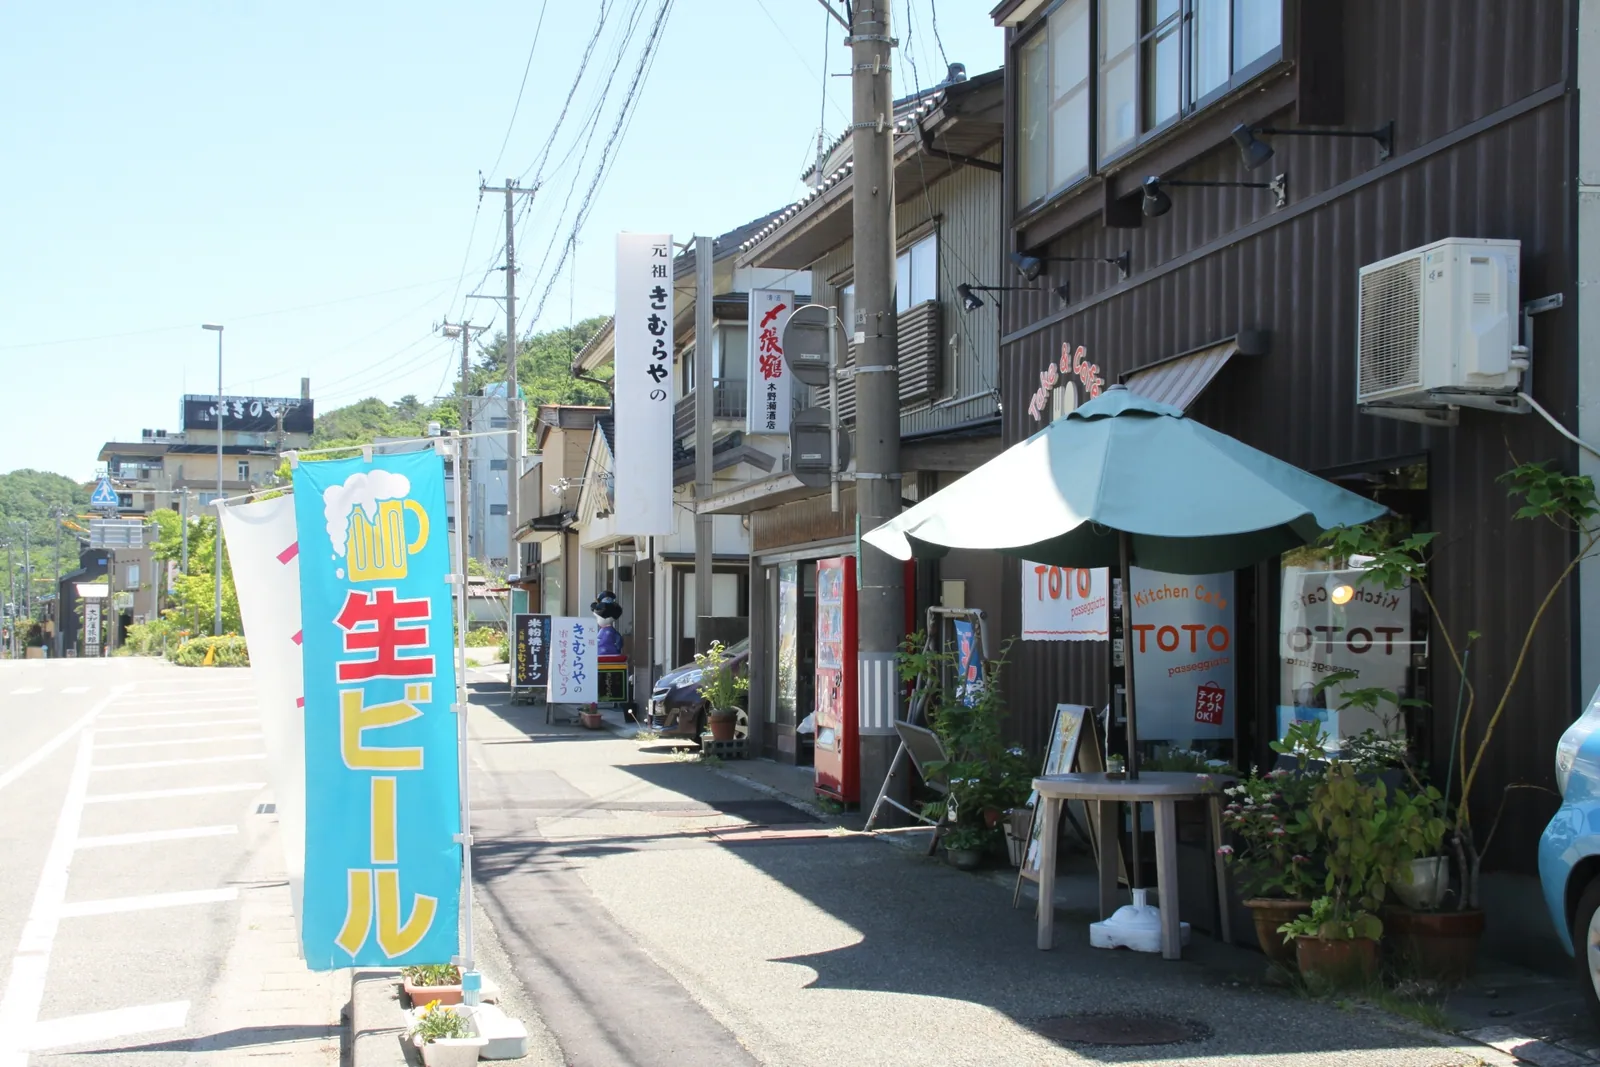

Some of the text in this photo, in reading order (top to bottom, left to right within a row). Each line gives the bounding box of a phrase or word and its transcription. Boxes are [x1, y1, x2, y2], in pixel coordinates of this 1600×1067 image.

[1034, 565, 1091, 601] TOTO
[1133, 584, 1189, 608] Kitchen
[1070, 597, 1106, 621] passeggiata
[527, 618, 542, 680] 米粉焼ドーナツ
[1132, 624, 1230, 653] TOTO
[572, 623, 586, 693] きむらやの
[1168, 657, 1230, 677] passeggiata
[1197, 700, 1222, 712] アウト
[1198, 690, 1223, 702] テイク
[1196, 711, 1213, 722] OK!
[333, 588, 438, 960] 生ビール
